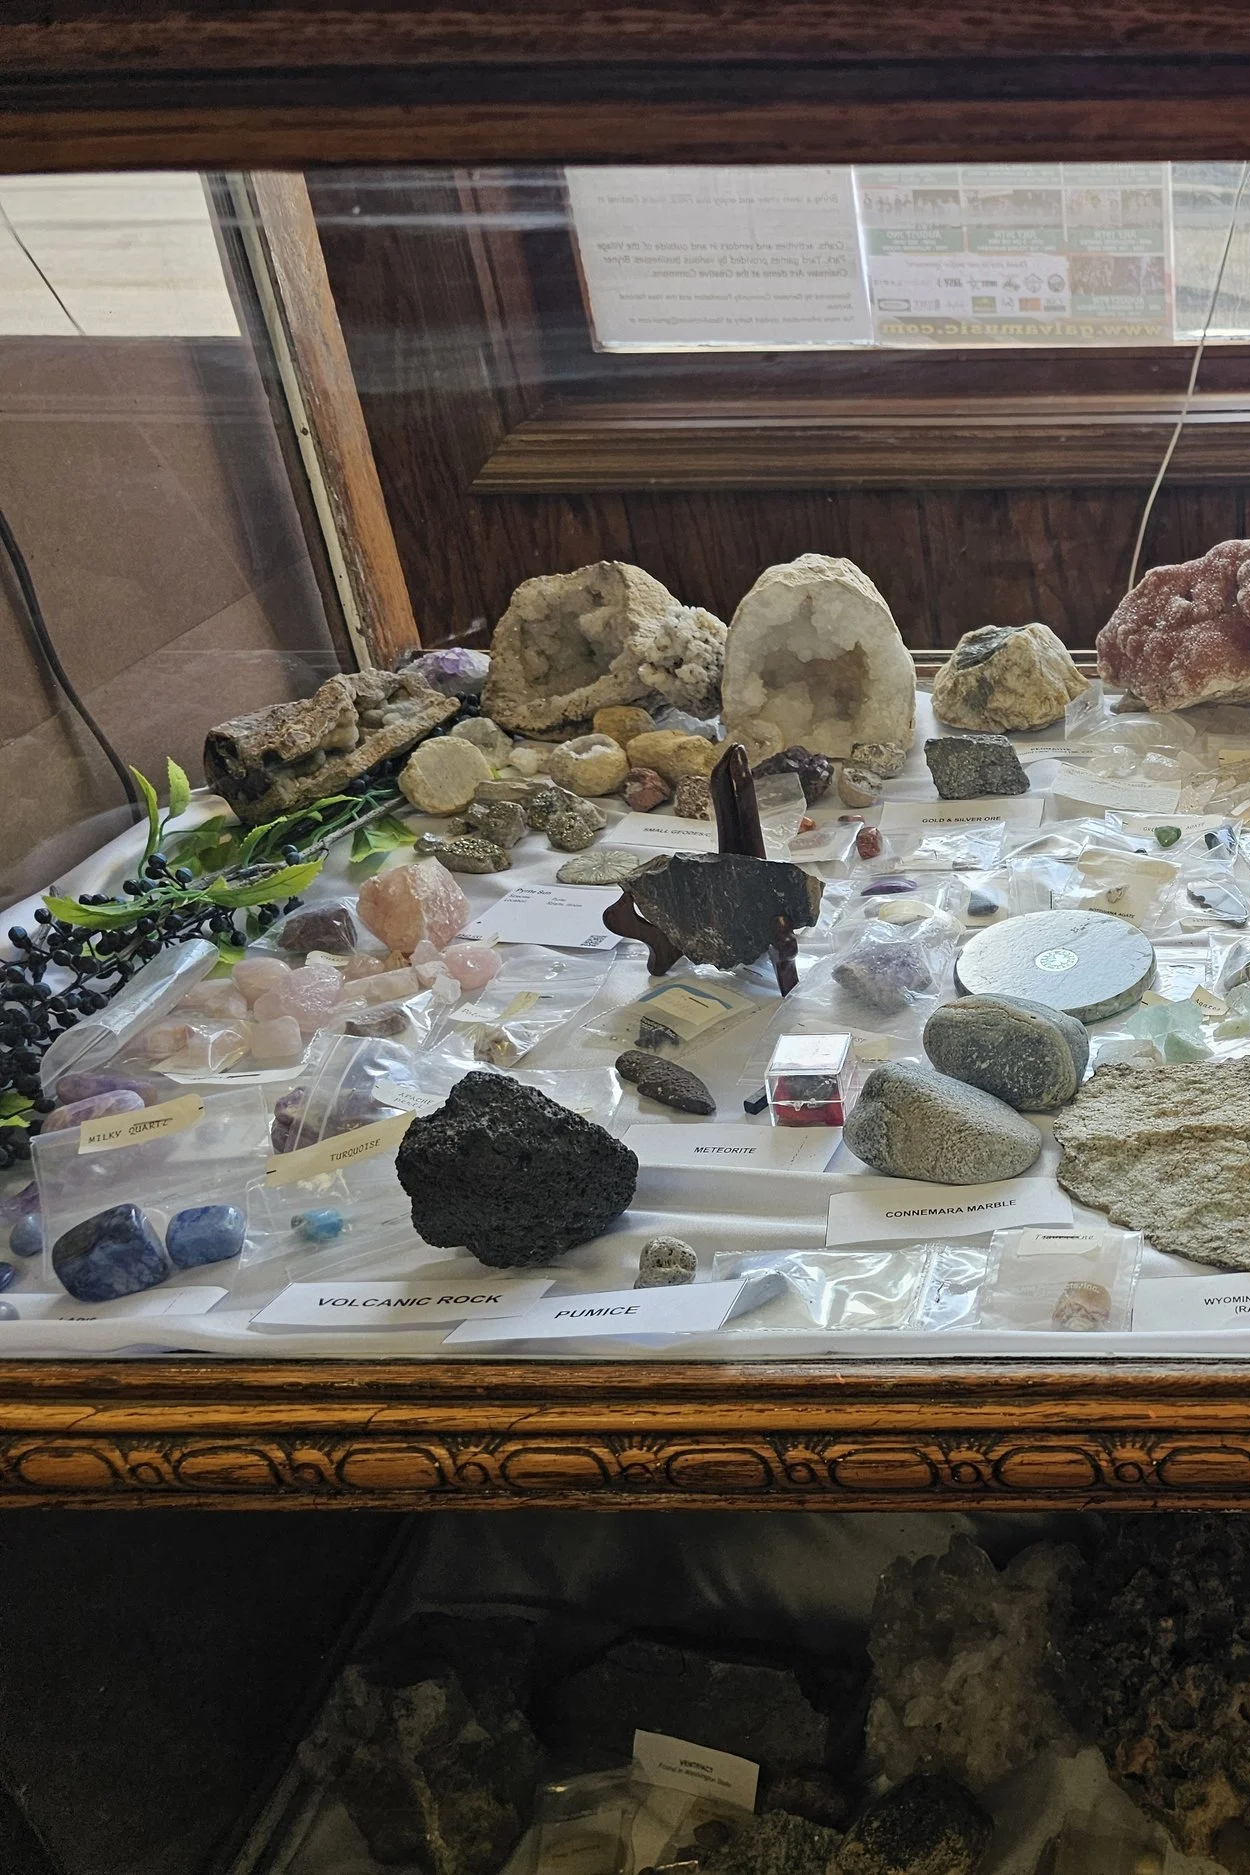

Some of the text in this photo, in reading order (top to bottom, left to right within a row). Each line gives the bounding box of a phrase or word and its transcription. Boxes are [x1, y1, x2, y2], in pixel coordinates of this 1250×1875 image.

[88, 1119, 169, 1144] MILKY QUARTZ
[330, 1138, 382, 1162] TURQUOISE
[693, 1146, 757, 1154] METEORITE
[885, 1199, 1017, 1219] CONNEMARA MARBLE
[318, 1294, 503, 1307] VOLCANIC ROCK
[554, 1305, 641, 1319] PUMICE
